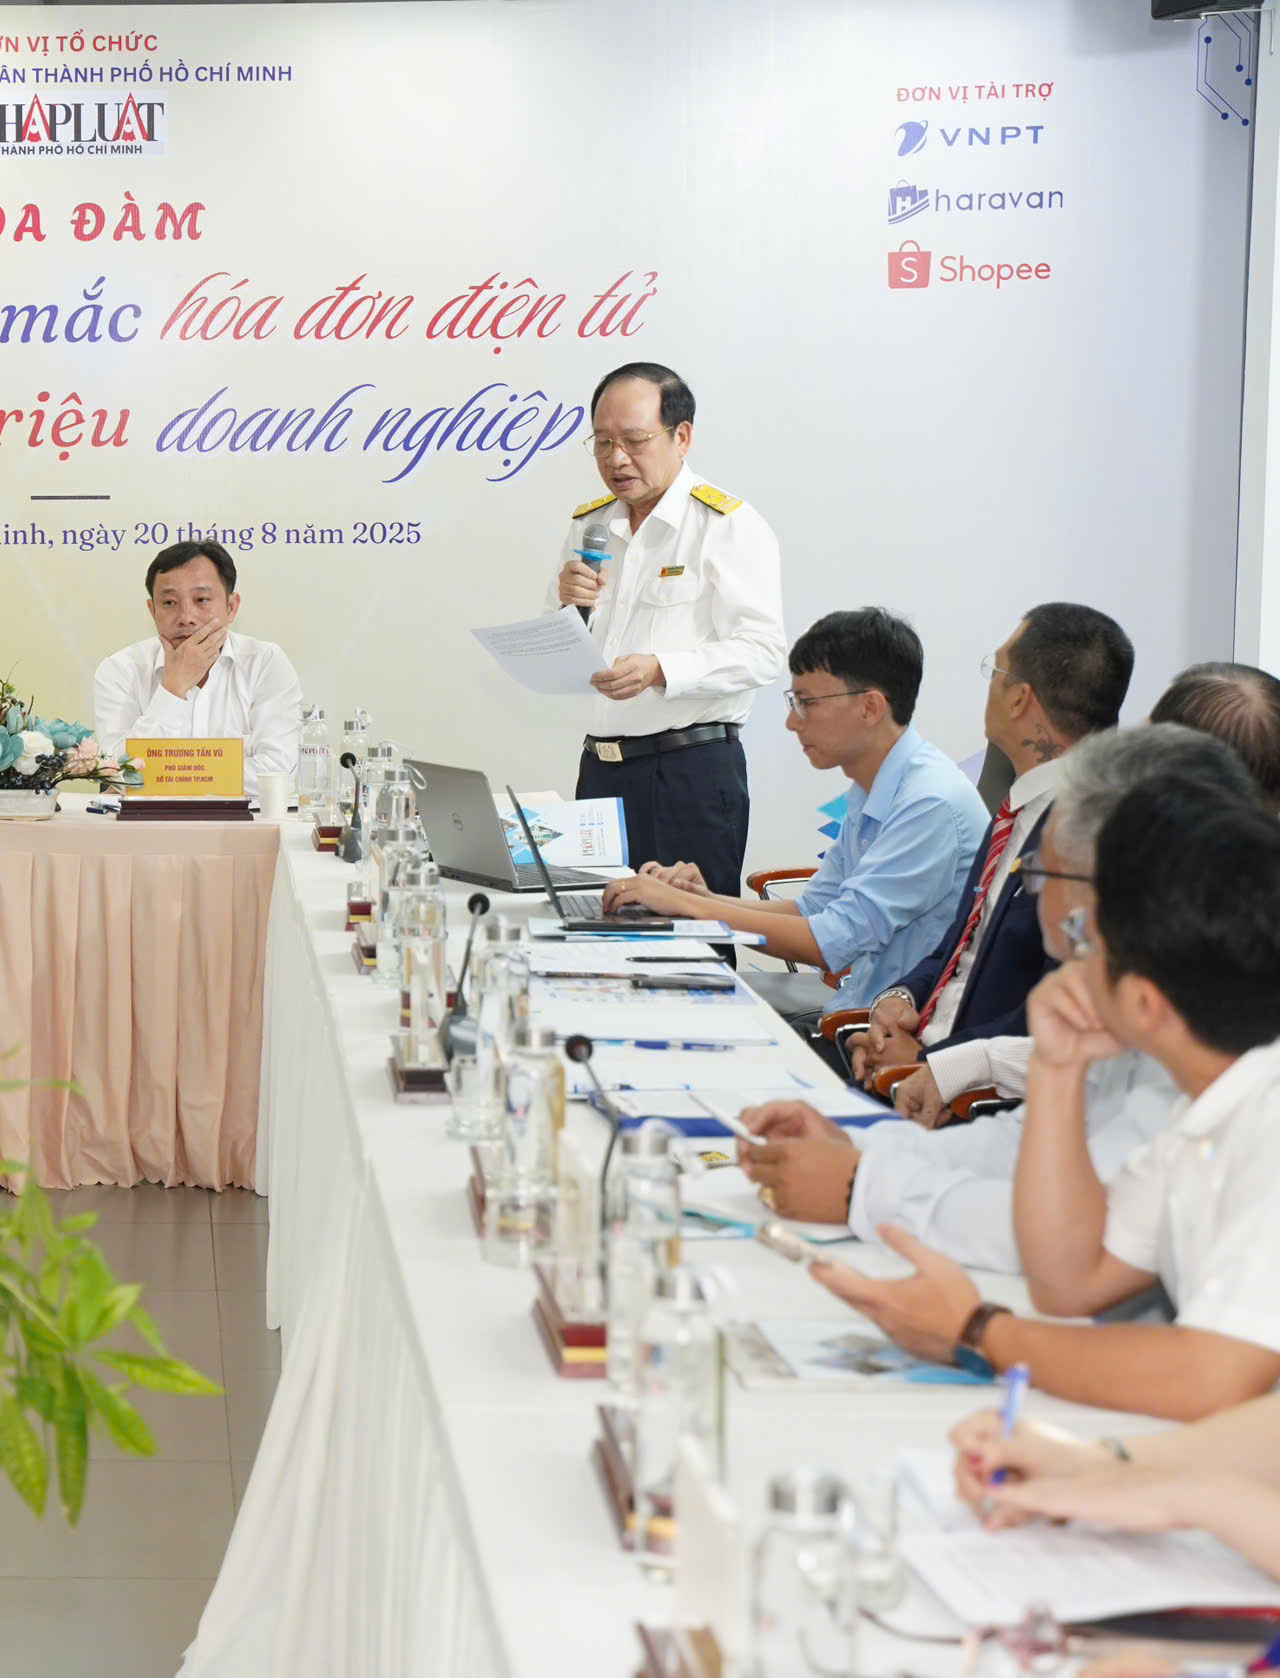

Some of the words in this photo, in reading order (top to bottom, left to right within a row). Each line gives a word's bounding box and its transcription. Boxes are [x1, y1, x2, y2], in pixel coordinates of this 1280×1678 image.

[27, 35, 49, 56] VỊ
[56, 29, 86, 52] TỔ
[93, 31, 158, 52] CHỨC
[32, 64, 105, 83] THÀNH
[110, 60, 153, 83] PHỐ
[159, 63, 191, 82] HỒ
[195, 64, 232, 82] CHÍ
[236, 66, 293, 82] MINH
[896, 86, 941, 102] ĐƠN
[948, 85, 969, 104] VỊ
[974, 82, 1006, 101] TÀI
[1012, 81, 1055, 102] TRỢ
[87, 142, 108, 155] CHÍ
[110, 144, 143, 155] MINH
[939, 125, 1045, 147] VNPT
[934, 188, 1064, 212] haravan
[70, 191, 206, 241] ĐÀM
[938, 254, 1051, 289] Shopee
[0, 276, 142, 344] mắc
[160, 271, 284, 341] hóa
[293, 272, 415, 341] đơn
[425, 271, 567, 356] điện
[576, 271, 659, 338] tử
[155, 383, 377, 454] doanh
[362, 382, 586, 484] nghiệp
[61, 524, 127, 552] ngày
[134, 521, 169, 545] 20
[175, 521, 255, 551] tháng
[261, 521, 277, 544] 8
[284, 522, 345, 545] năm
[352, 520, 422, 545] 2025
[146, 748, 163, 758] ÔNG
